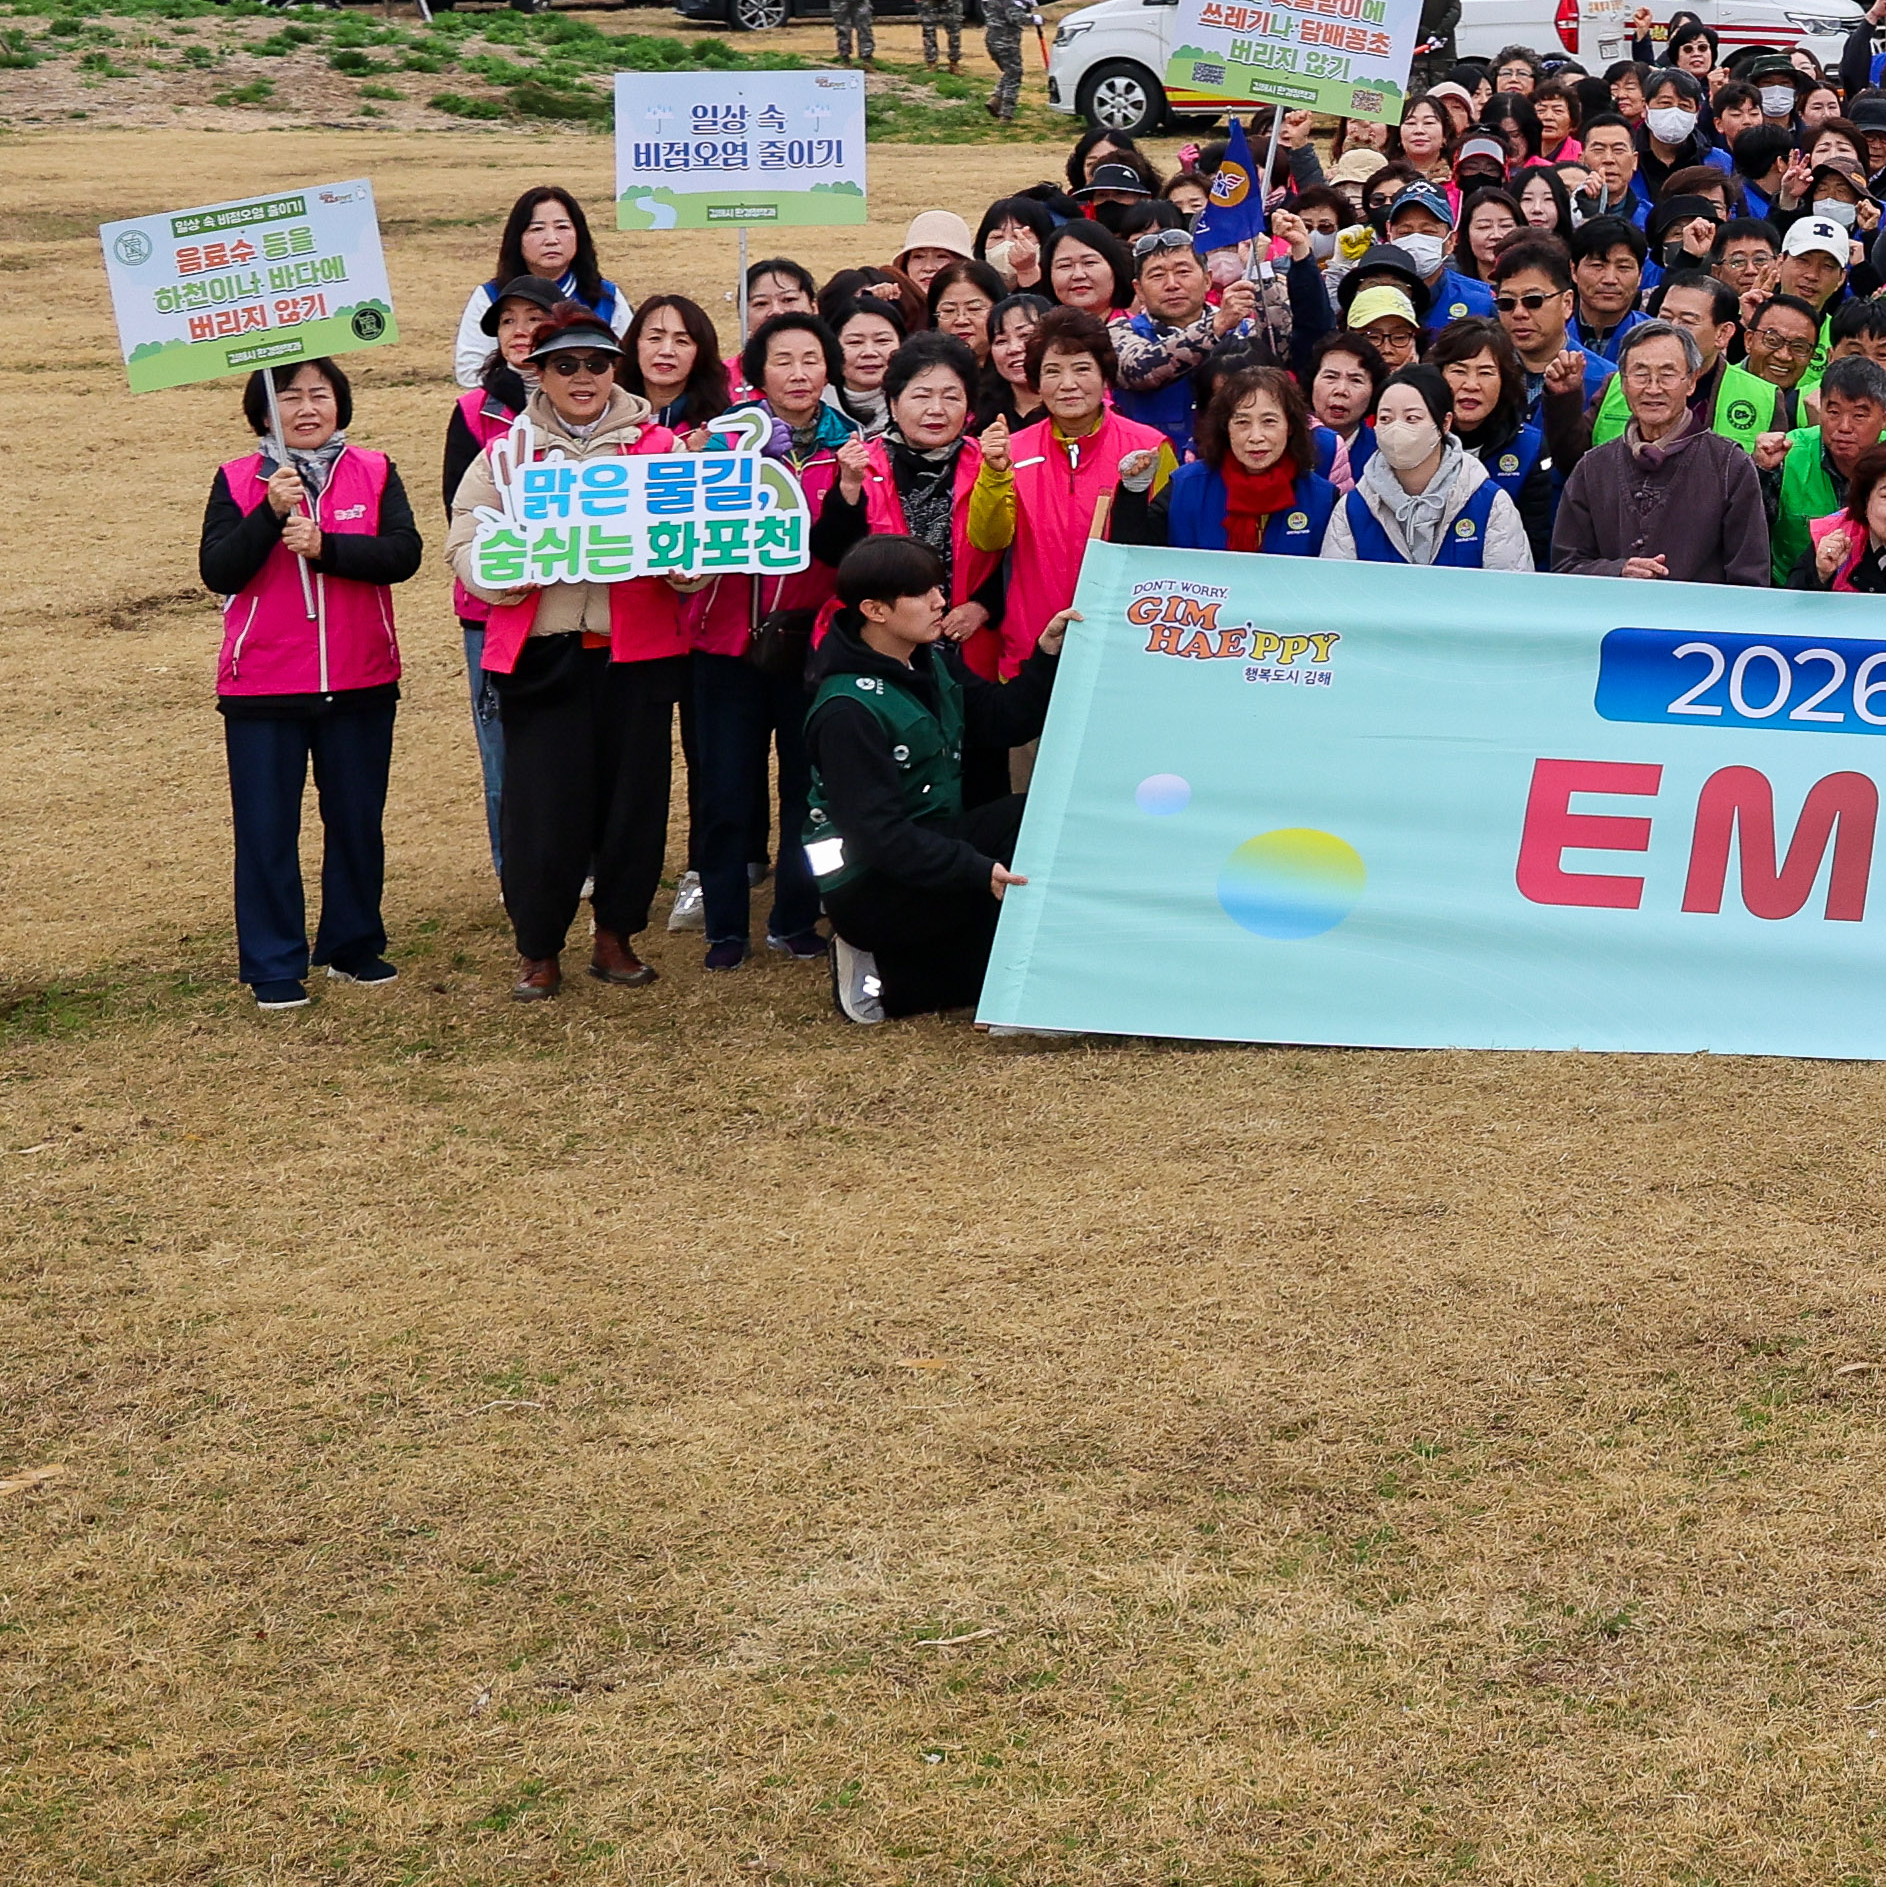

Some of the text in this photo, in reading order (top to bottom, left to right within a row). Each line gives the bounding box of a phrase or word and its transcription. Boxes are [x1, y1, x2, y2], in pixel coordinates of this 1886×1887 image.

[1198, 1, 1393, 58] 쓰레기나 담배꽁초
[1228, 38, 1351, 83] 버리지 않기
[691, 104, 787, 134] 일상 속
[633, 139, 844, 171] 비점오염 줄이기
[175, 226, 317, 274] 음료수 등을
[154, 255, 348, 313] 하천이나 바다에
[188, 294, 329, 342] 버리지 않기
[523, 457, 770, 520] 맑은 물길,
[479, 516, 801, 581] 숨쉬는 화포천
[1133, 580, 1176, 596] DON'T
[1127, 596, 1222, 630] GIM
[1245, 667, 1331, 686] 행복도시 김해
